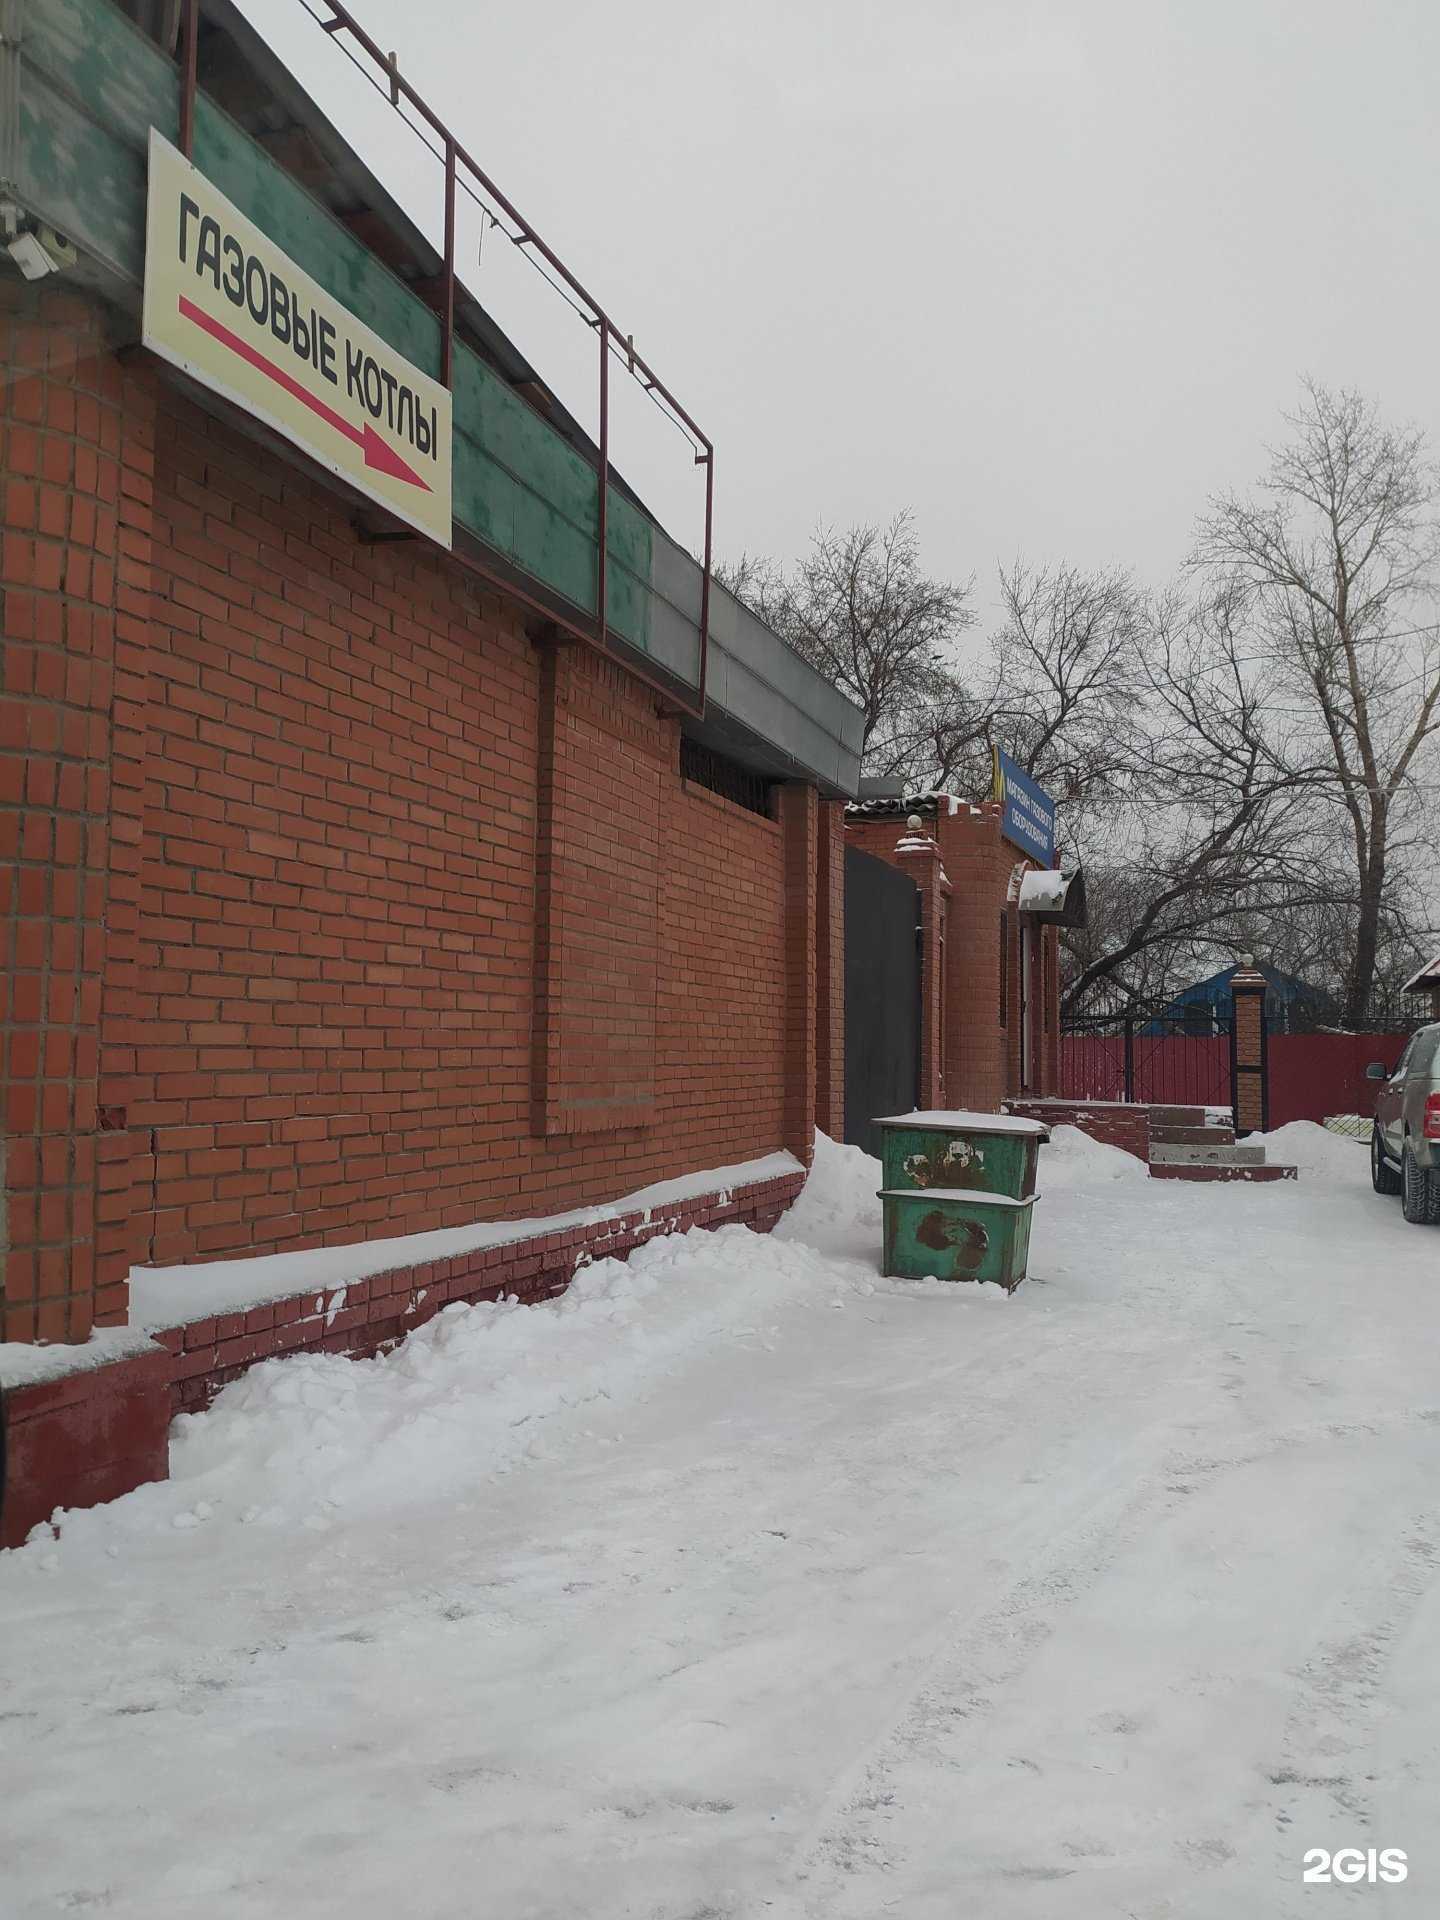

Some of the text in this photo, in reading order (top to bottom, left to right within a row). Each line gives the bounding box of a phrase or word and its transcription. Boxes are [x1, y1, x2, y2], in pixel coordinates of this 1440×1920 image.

[178, 192, 437, 461] ГАЗОВЫЕ КОТЛЫ
[1006, 776, 1053, 832] МАГАЗИН ГАЗОВОГО
